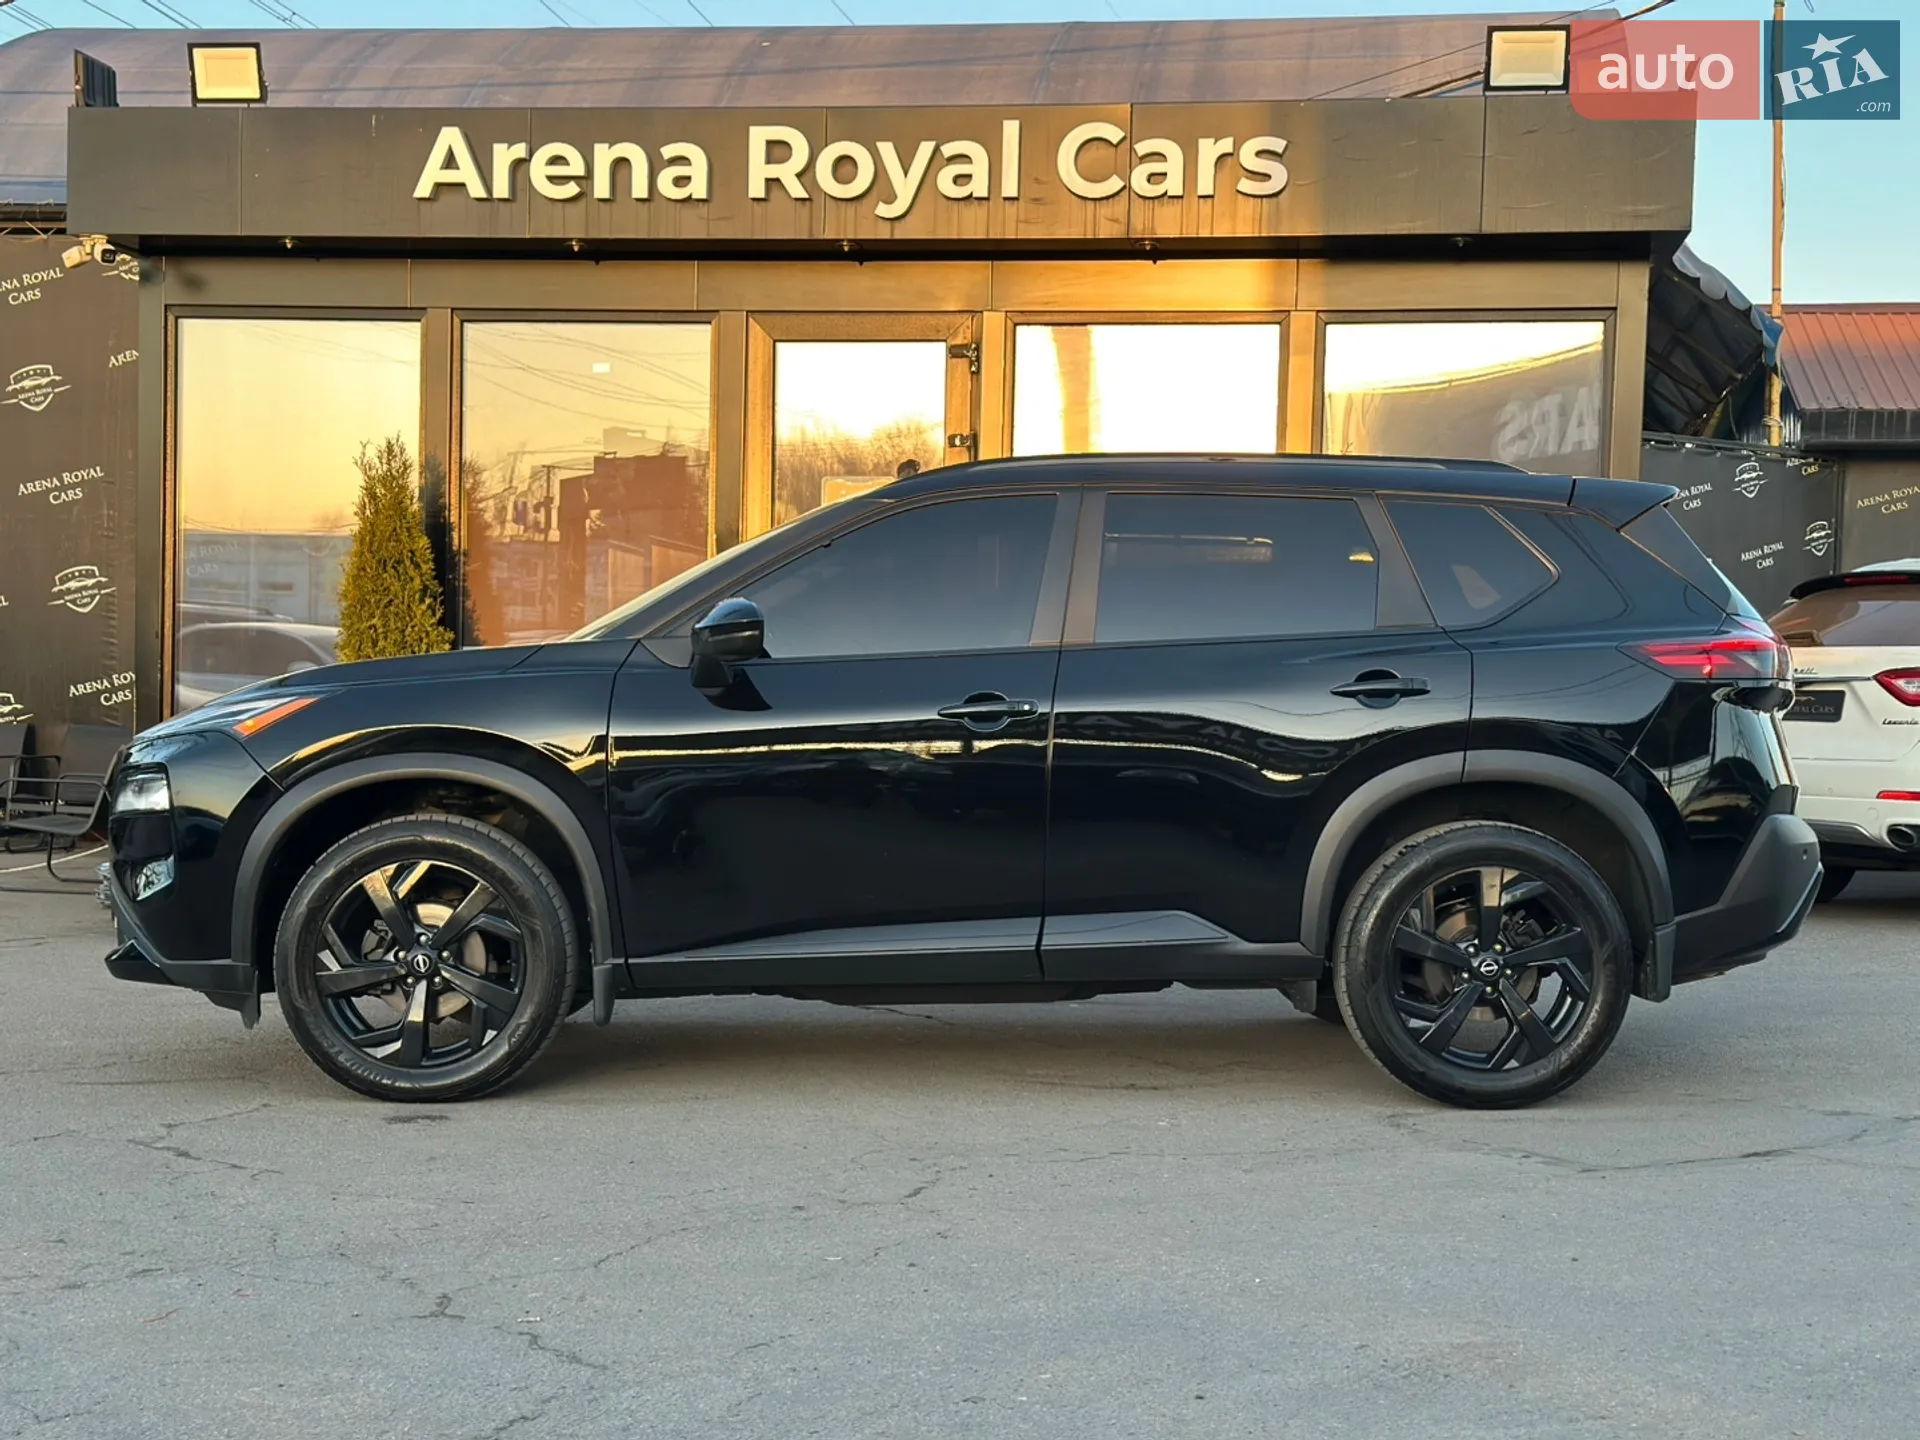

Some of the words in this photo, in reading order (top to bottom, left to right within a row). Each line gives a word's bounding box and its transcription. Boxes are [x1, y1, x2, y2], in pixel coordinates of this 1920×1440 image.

[412, 126, 710, 200] Arena
[748, 119, 1021, 219] Royal
[1056, 121, 1289, 199] Cars
[22, 267, 64, 286] ROYAL
[8, 288, 41, 305] CARS
[18, 477, 60, 496] ARENA
[62, 466, 105, 485] ROYAL
[49, 488, 83, 505] CARS
[1683, 498, 1702, 511] CARS
[1856, 493, 1891, 509] ARENA
[1881, 500, 1908, 514] CARS
[1756, 557, 1774, 570] CARS
[69, 679, 111, 698] ARENA
[100, 689, 132, 706] CARS
